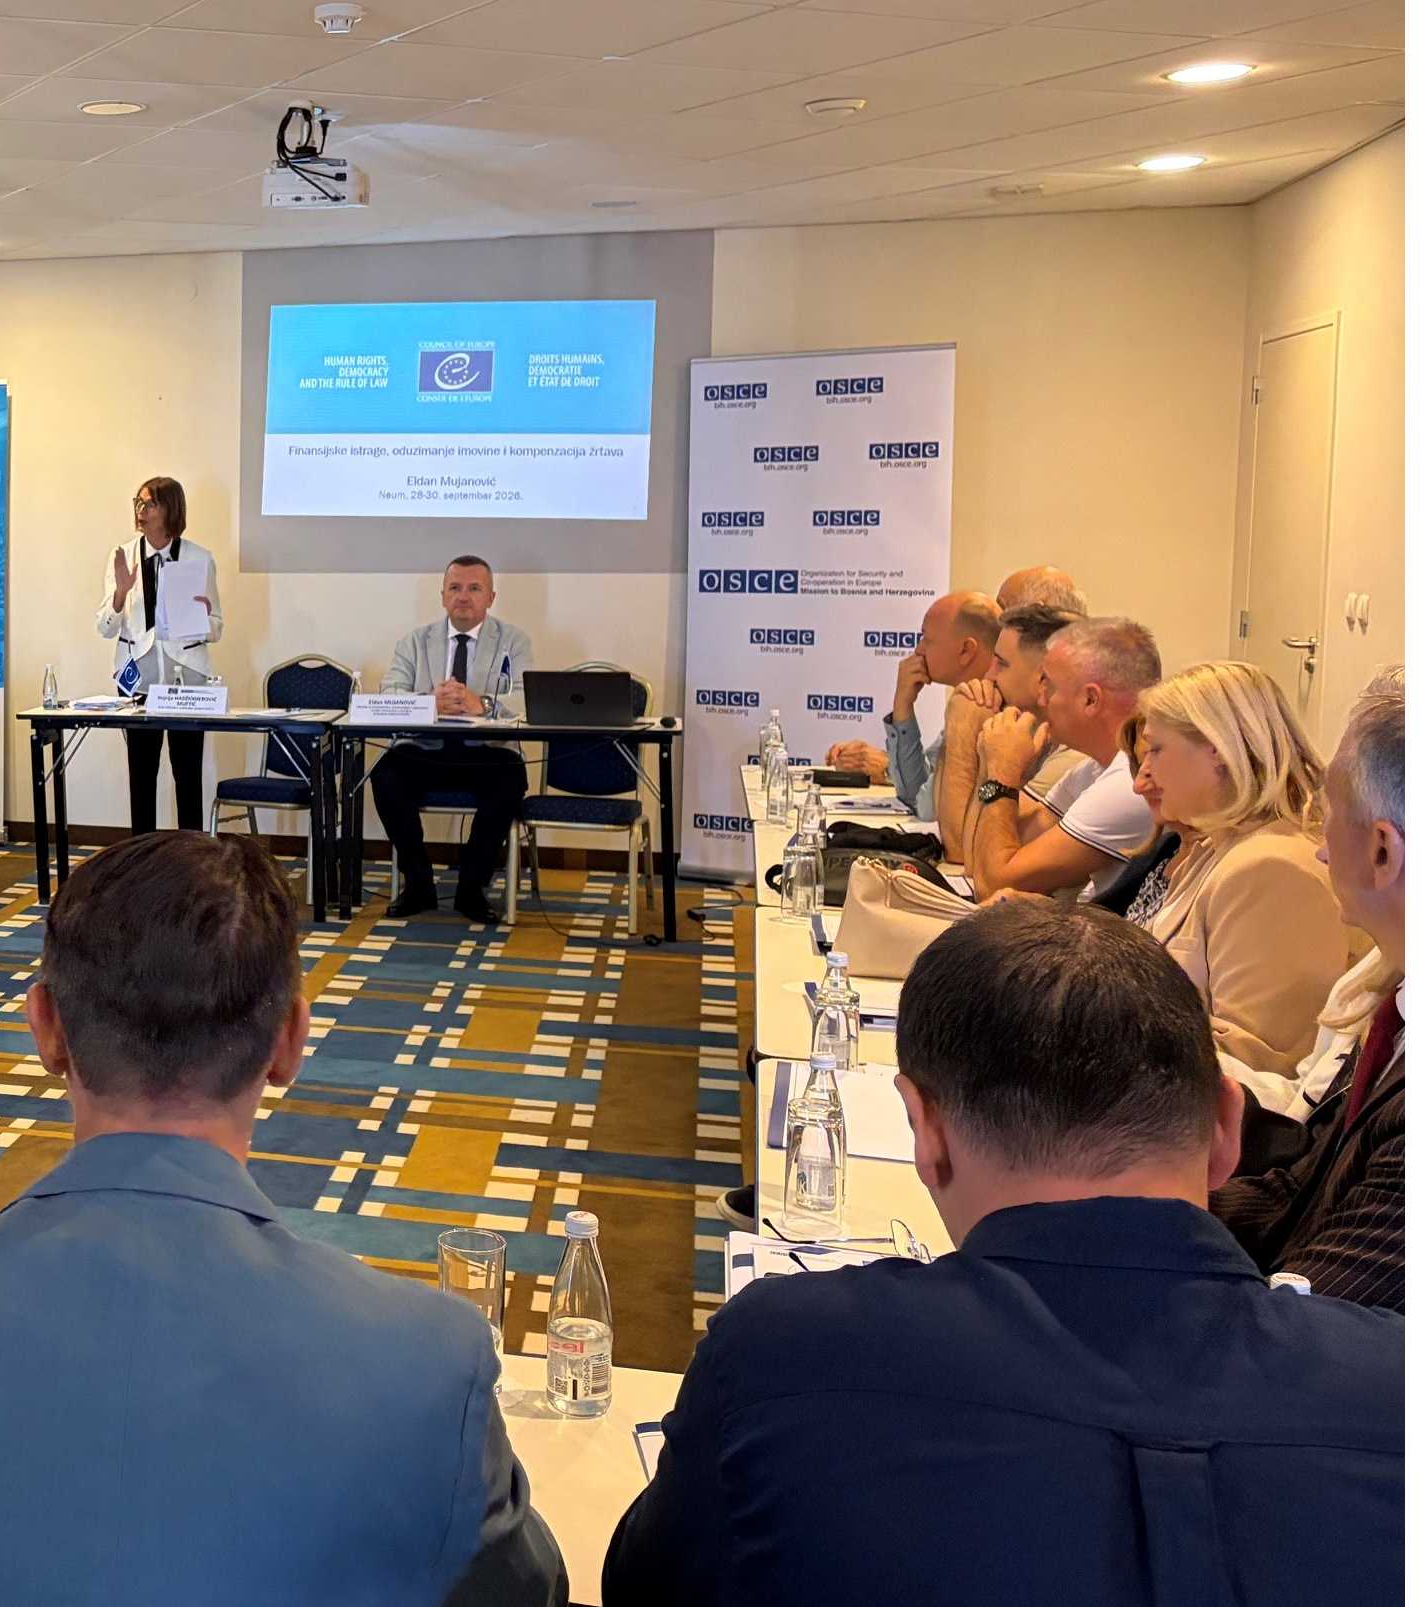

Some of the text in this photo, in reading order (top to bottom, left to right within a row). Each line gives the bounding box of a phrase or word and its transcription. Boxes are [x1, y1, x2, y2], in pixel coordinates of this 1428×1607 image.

[324, 355, 388, 367] HUMAN RIGHTS,
[529, 354, 559, 364] DROITS
[339, 367, 388, 377] DEMOCRACY
[300, 378, 388, 389] AND THE RULE OF LAW
[528, 376, 538, 387] ET
[561, 376, 572, 387] DE
[574, 376, 600, 387] DROIT
[817, 378, 883, 395] osce
[705, 384, 767, 400] osce
[288, 445, 347, 458] Finansijske
[350, 445, 389, 458] istrage,
[392, 445, 455, 458] oduzimanje
[458, 445, 500, 456] imovine
[510, 445, 586, 459] kompenzacija
[754, 447, 818, 462] osce
[870, 443, 938, 459] osce
[407, 475, 497, 488] Eldan Mujanović
[703, 513, 764, 527] osce
[814, 511, 879, 526] osce
[701, 571, 797, 592] osce
[886, 589, 935, 597] Herzegovina
[751, 629, 814, 645] osce
[865, 633, 923, 647] osc
[697, 690, 759, 706] osce
[808, 695, 872, 712] osce
